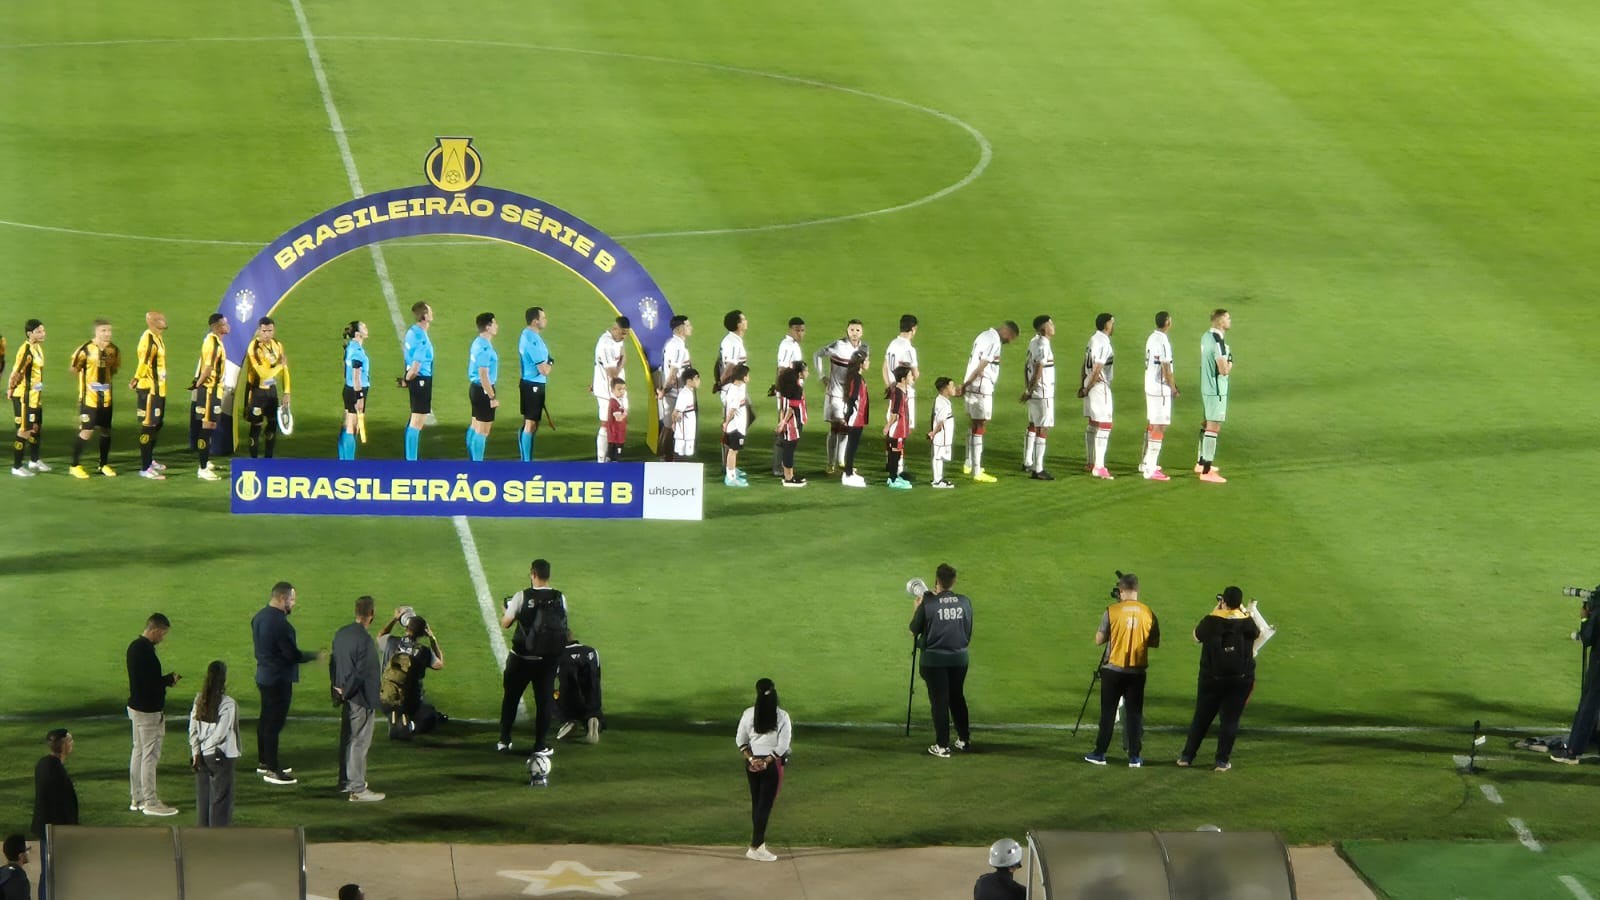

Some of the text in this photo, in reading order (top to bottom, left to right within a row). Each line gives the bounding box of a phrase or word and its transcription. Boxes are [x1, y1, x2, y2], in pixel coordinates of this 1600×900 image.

[274, 194, 616, 273] BRASILEIRÃO SÉRIE B
[266, 473, 633, 503] BRASILEIRÃO SÉRIE B
[648, 486, 695, 498] uhlsport
[937, 607, 963, 620] 1892
